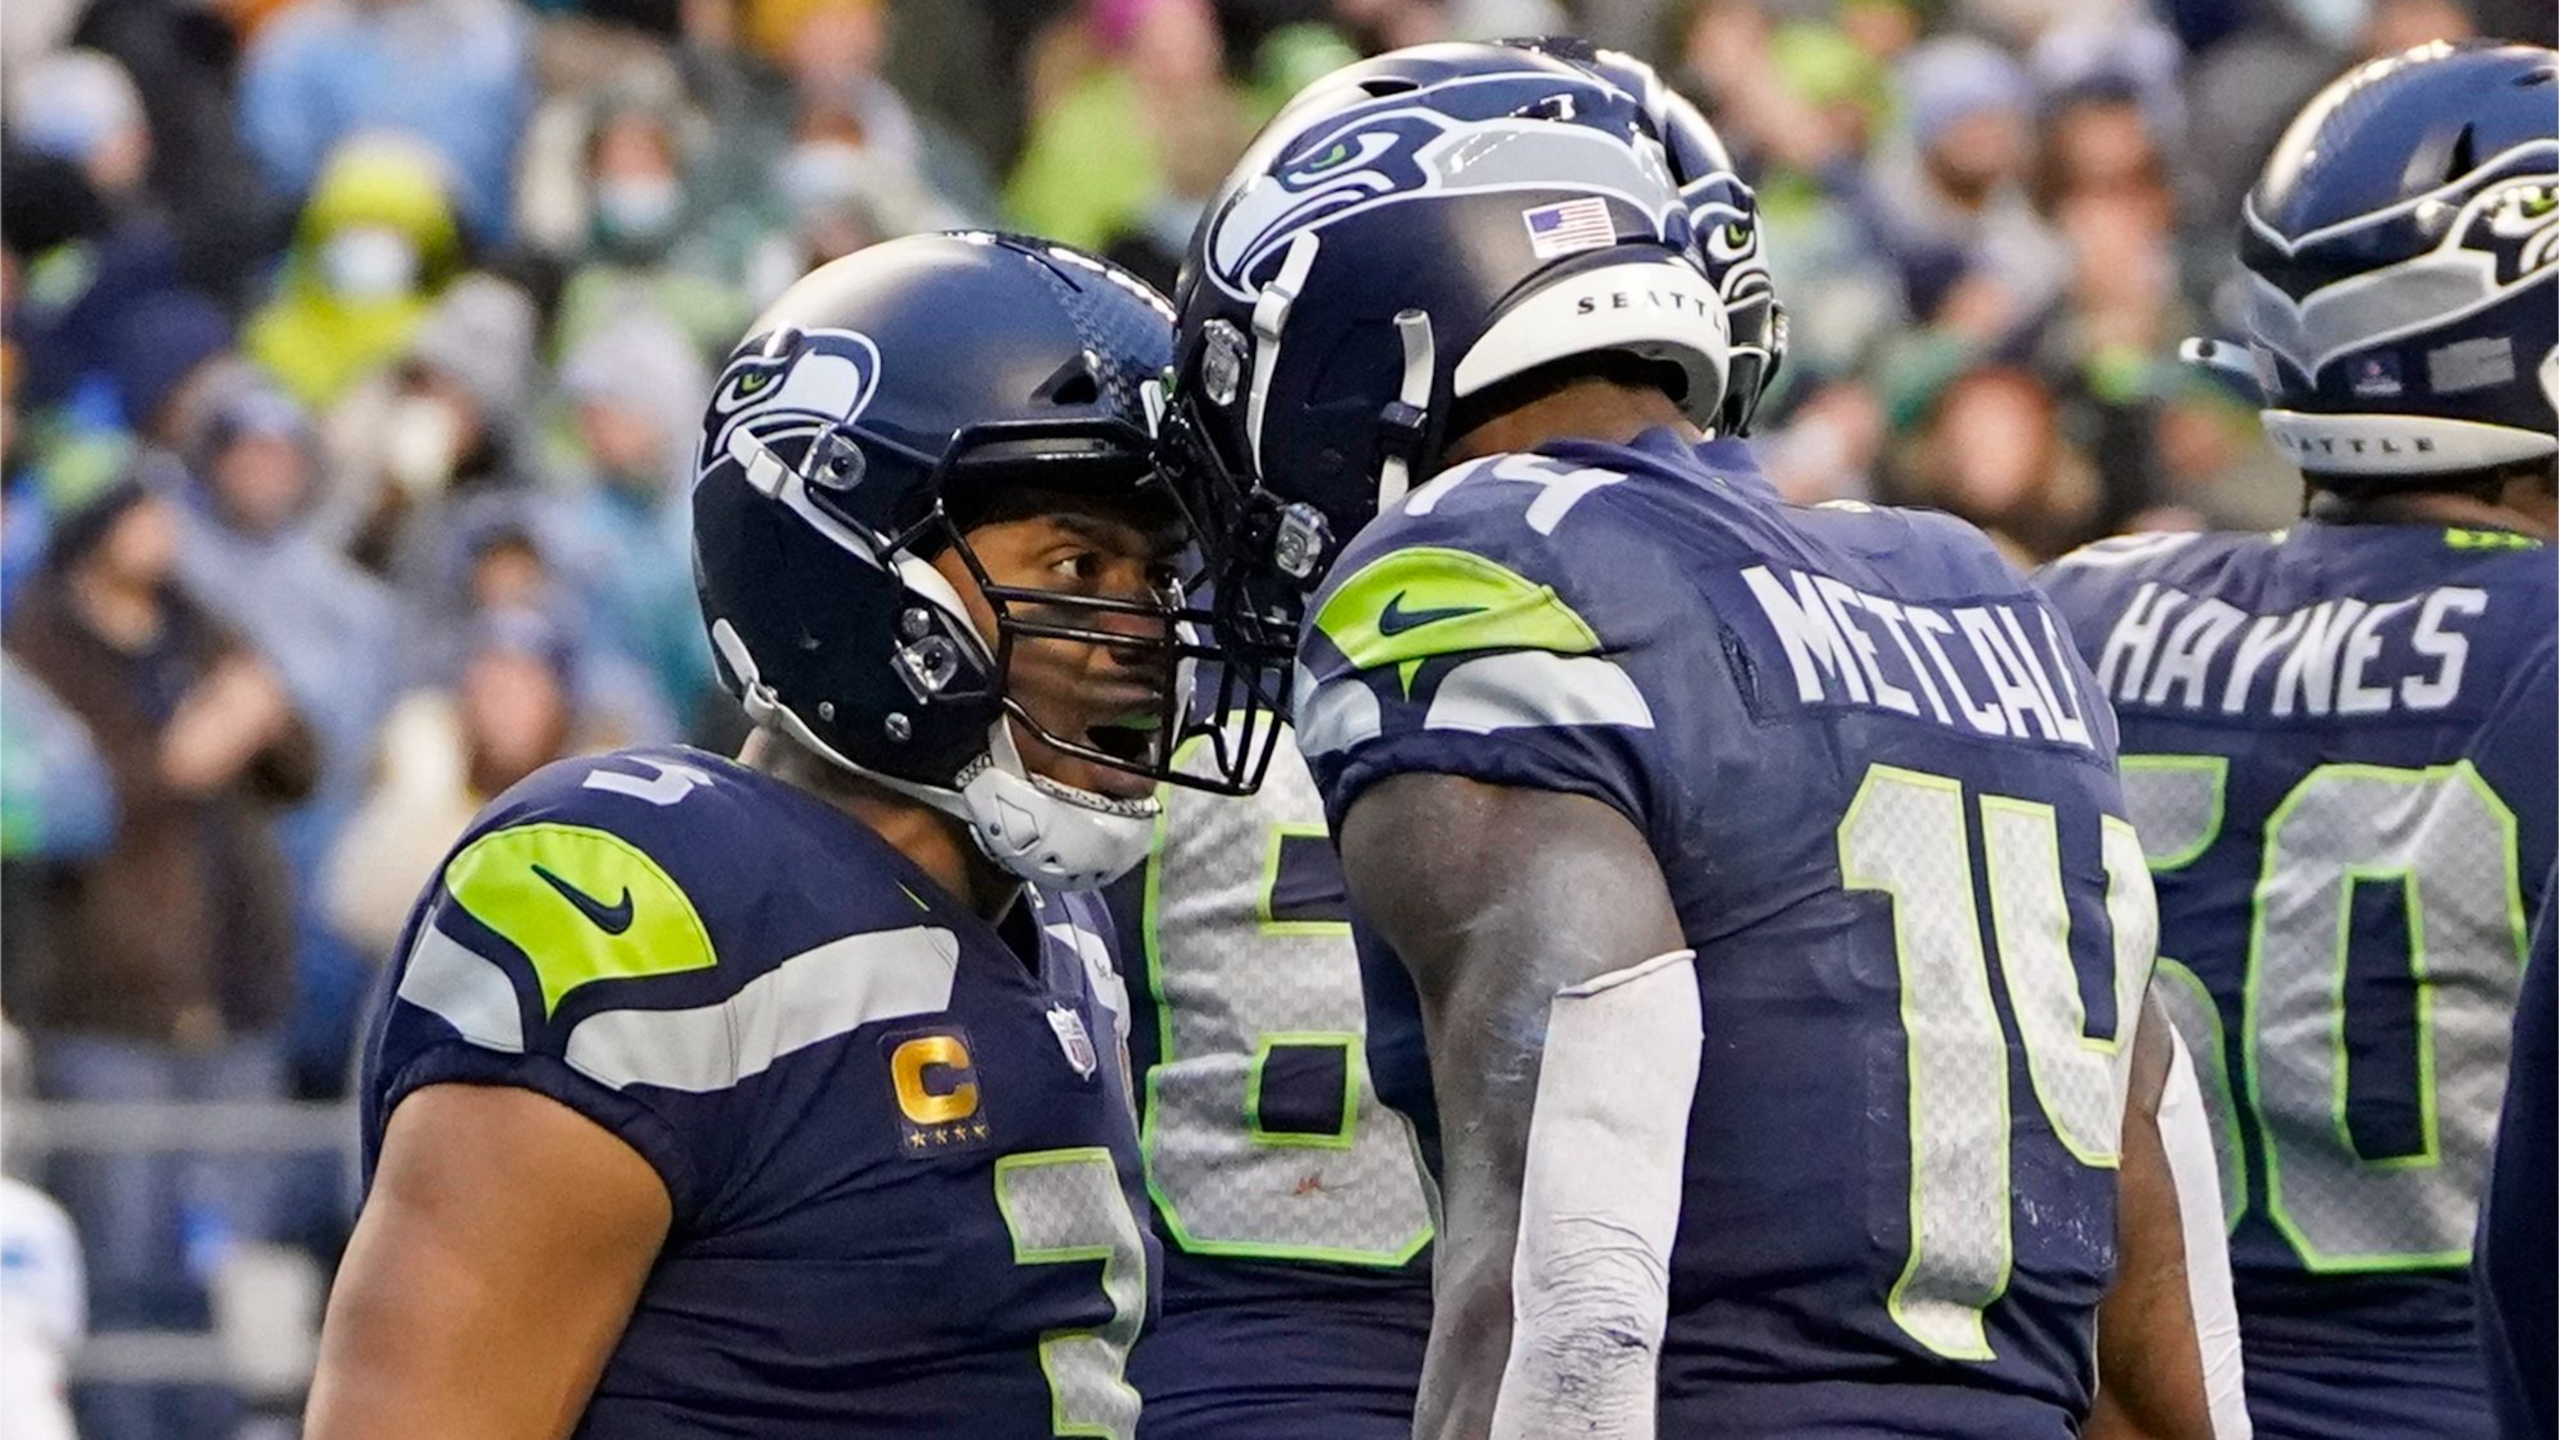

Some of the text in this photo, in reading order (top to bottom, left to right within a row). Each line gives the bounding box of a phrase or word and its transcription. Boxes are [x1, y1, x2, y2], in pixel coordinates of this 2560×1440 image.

[1577, 290, 1724, 335] SEATTL
[2273, 431, 2435, 453] EATTLE
[1741, 565, 2095, 750] METCAL
[2096, 583, 2489, 717] HAYNES
[891, 1035, 979, 1125] C
[1837, 763, 2160, 1361] 14
